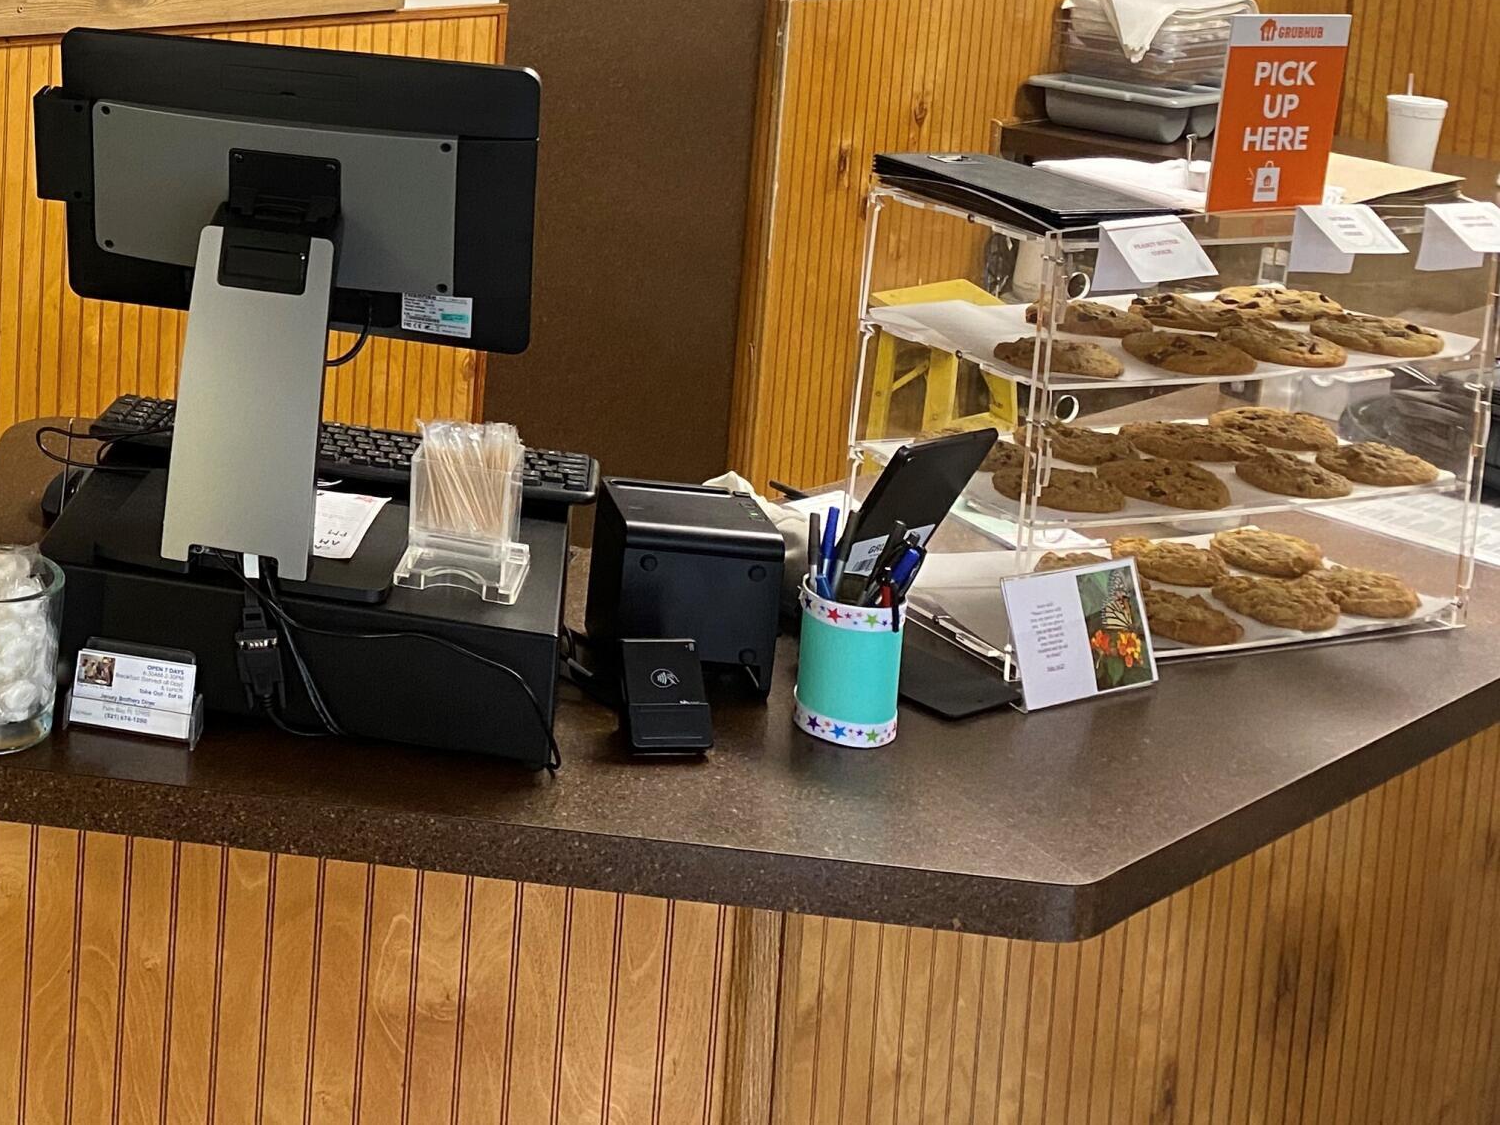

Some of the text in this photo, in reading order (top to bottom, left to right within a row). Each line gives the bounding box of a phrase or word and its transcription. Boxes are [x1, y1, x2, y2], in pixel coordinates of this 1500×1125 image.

[1278, 25, 1325, 40] GRUBHUB
[1253, 60, 1318, 87] PICK
[1262, 93, 1301, 120] UP
[1241, 125, 1310, 153] HERE
[147, 665, 164, 673] OPEN
